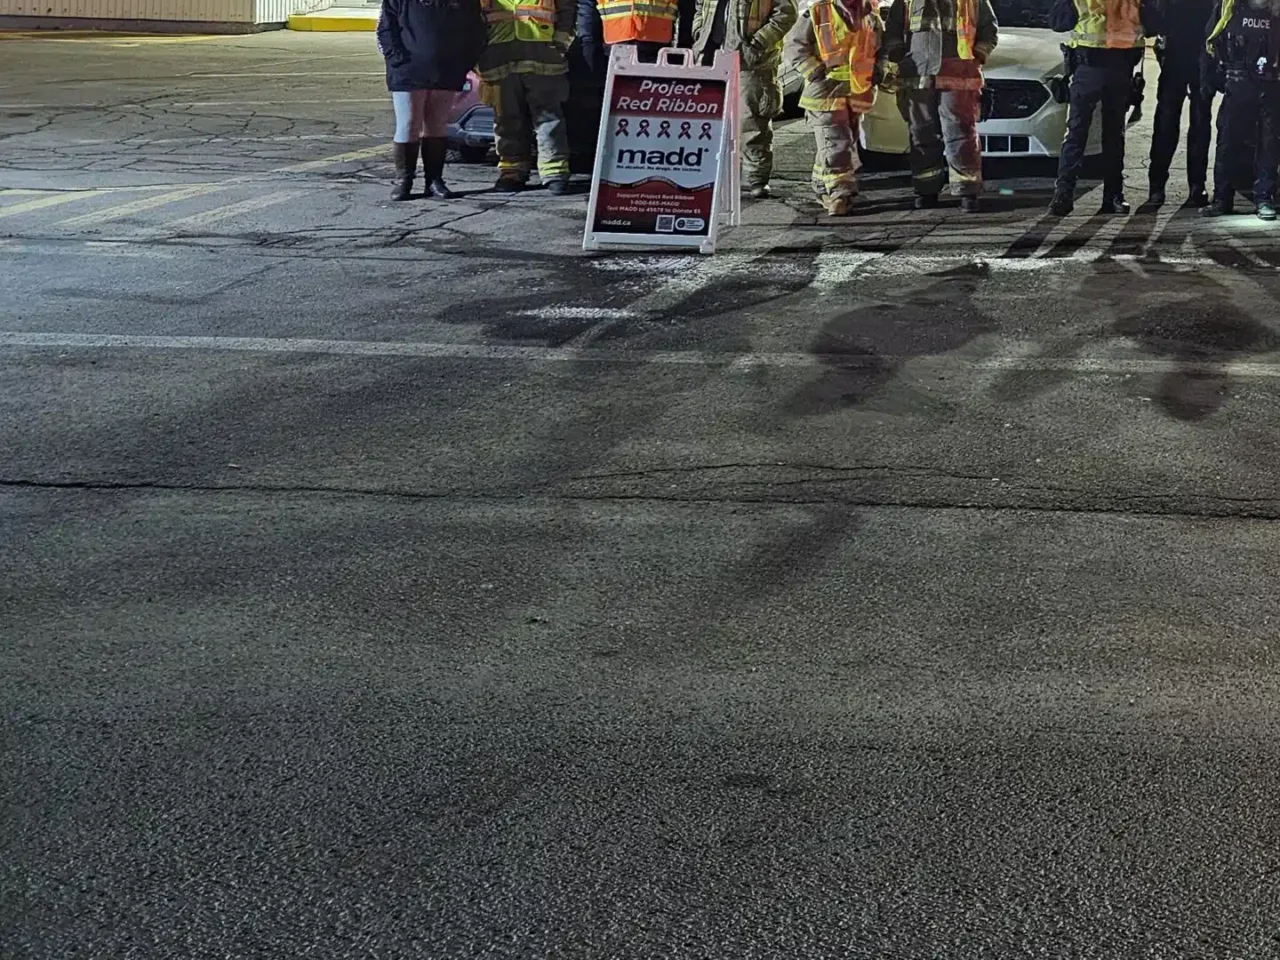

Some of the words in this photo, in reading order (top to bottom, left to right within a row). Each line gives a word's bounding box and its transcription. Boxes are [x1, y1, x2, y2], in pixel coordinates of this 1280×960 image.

[1242, 18, 1271, 29] POLICE
[639, 80, 702, 97] Project
[616, 96, 653, 111] Red
[656, 98, 719, 114] Ribbon
[617, 146, 703, 166] madd
